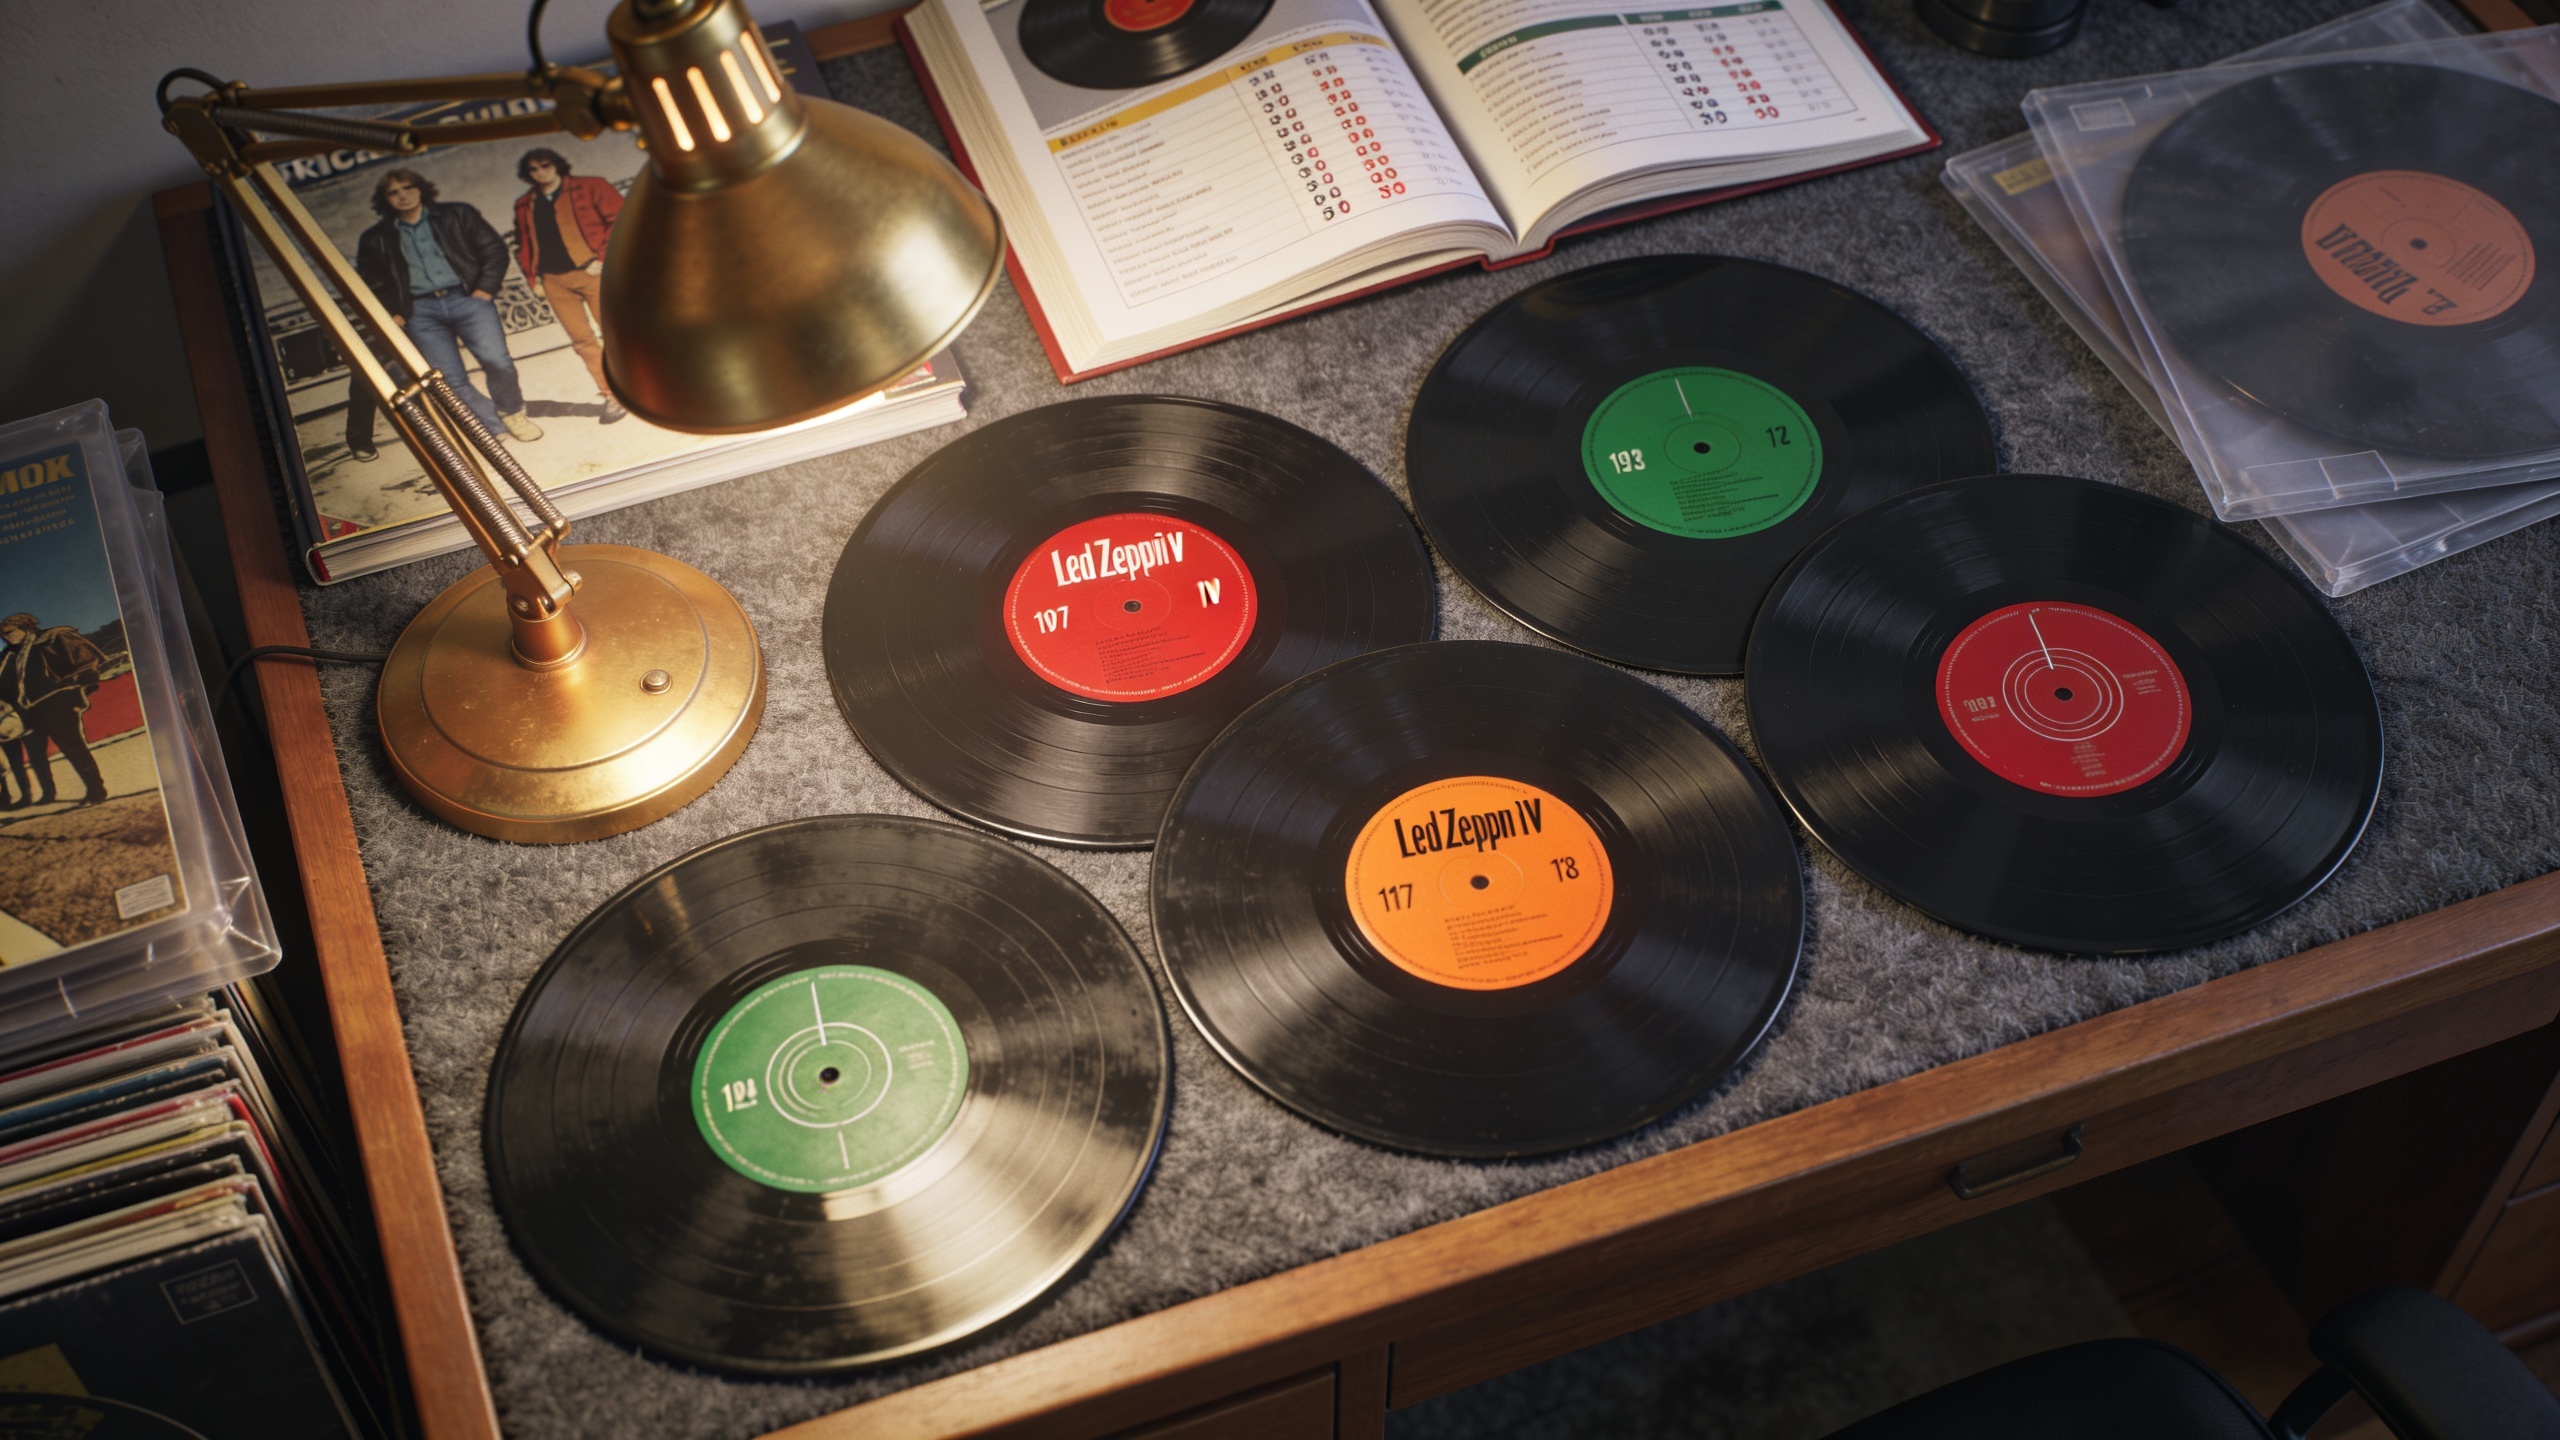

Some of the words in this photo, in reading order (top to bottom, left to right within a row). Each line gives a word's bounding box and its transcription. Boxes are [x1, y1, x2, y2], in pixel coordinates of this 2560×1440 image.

[1608, 448, 1646, 474] 193
[1051, 543, 1097, 587] Led
[1197, 577, 1220, 608] IV
[1033, 605, 1069, 634] 107
[1394, 811, 1443, 858] Led
[1514, 798, 1542, 836] IV
[1377, 883, 1414, 912] 117
